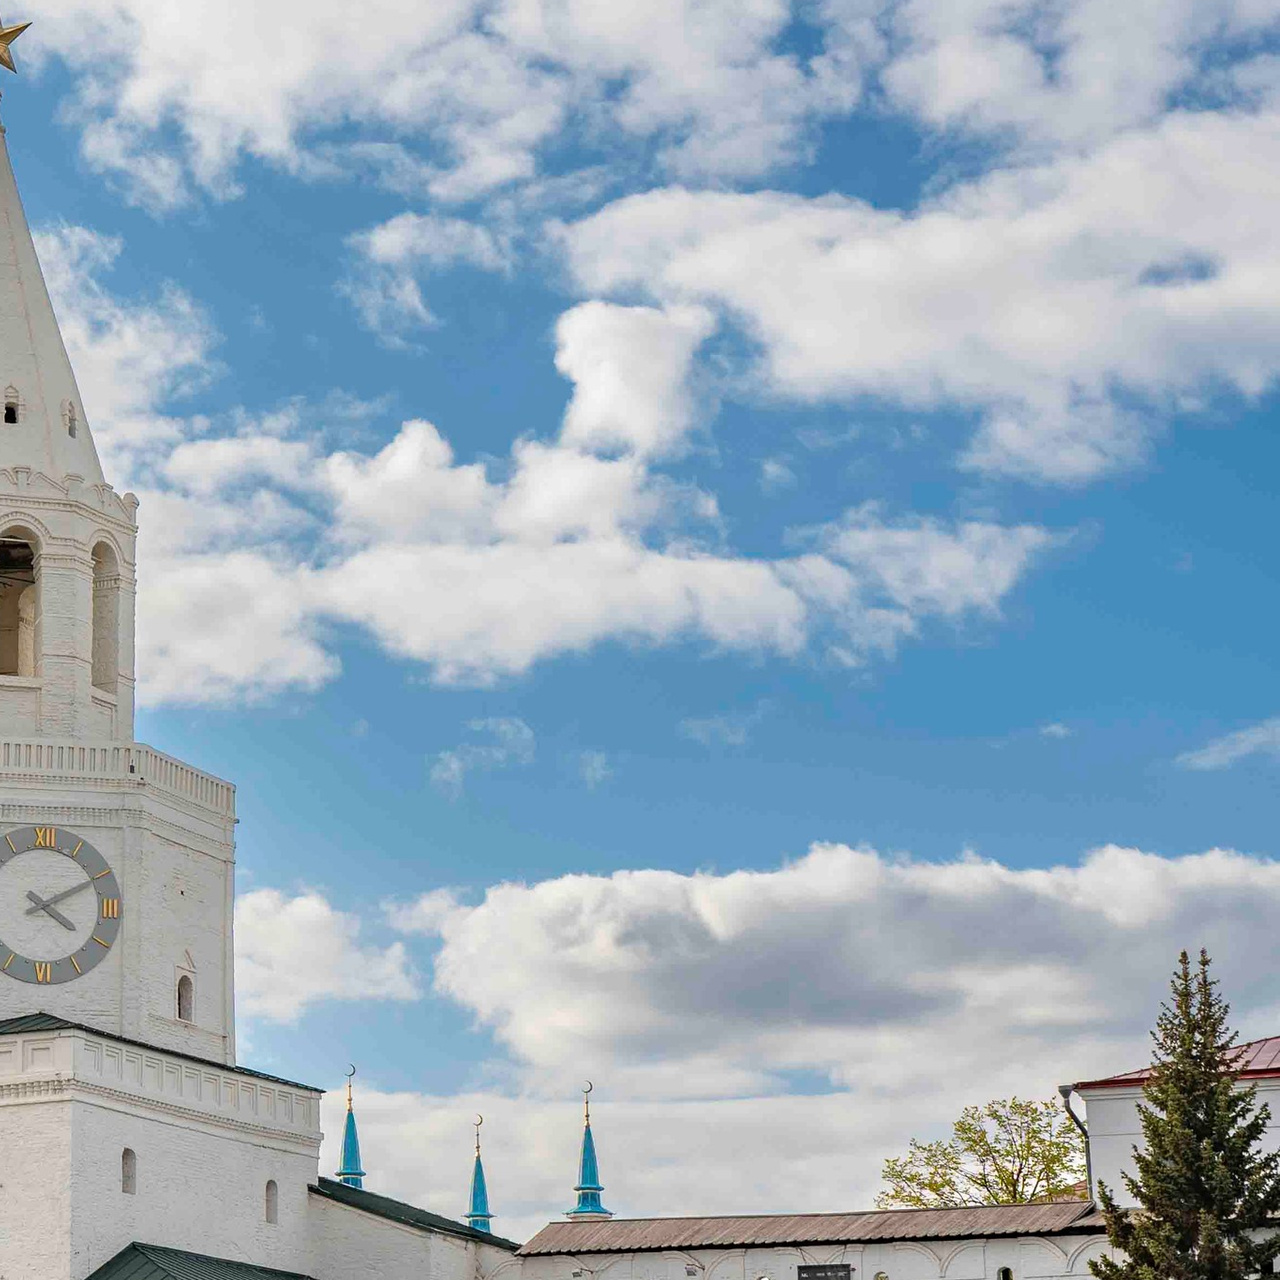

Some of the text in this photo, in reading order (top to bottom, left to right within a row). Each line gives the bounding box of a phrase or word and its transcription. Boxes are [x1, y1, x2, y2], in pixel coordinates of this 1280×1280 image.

[35, 827, 56, 847] XII
[102, 898, 119, 918] III
[35, 962, 52, 983] VI
